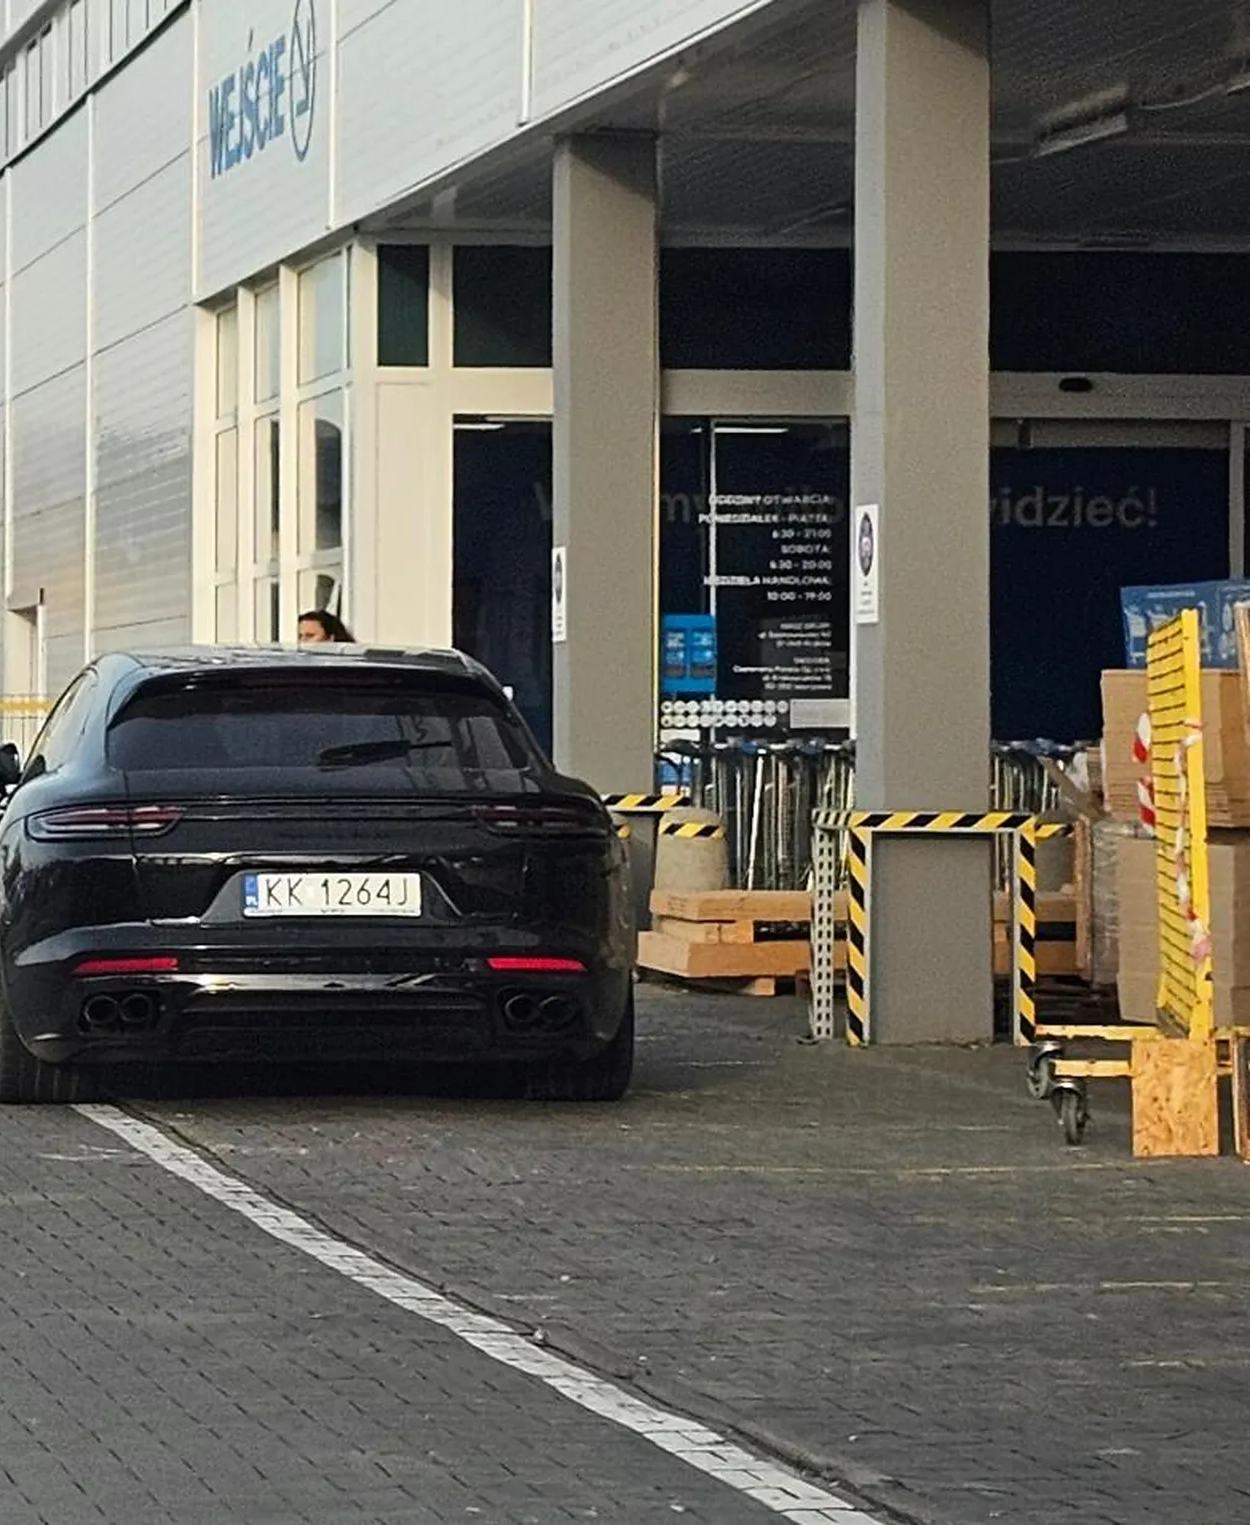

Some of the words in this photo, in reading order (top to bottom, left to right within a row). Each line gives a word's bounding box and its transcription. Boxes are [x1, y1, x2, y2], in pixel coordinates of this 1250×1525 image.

[208, 28, 286, 180] WEJŚCIE
[266, 878, 303, 907] KK
[320, 878, 408, 906] 1264J
